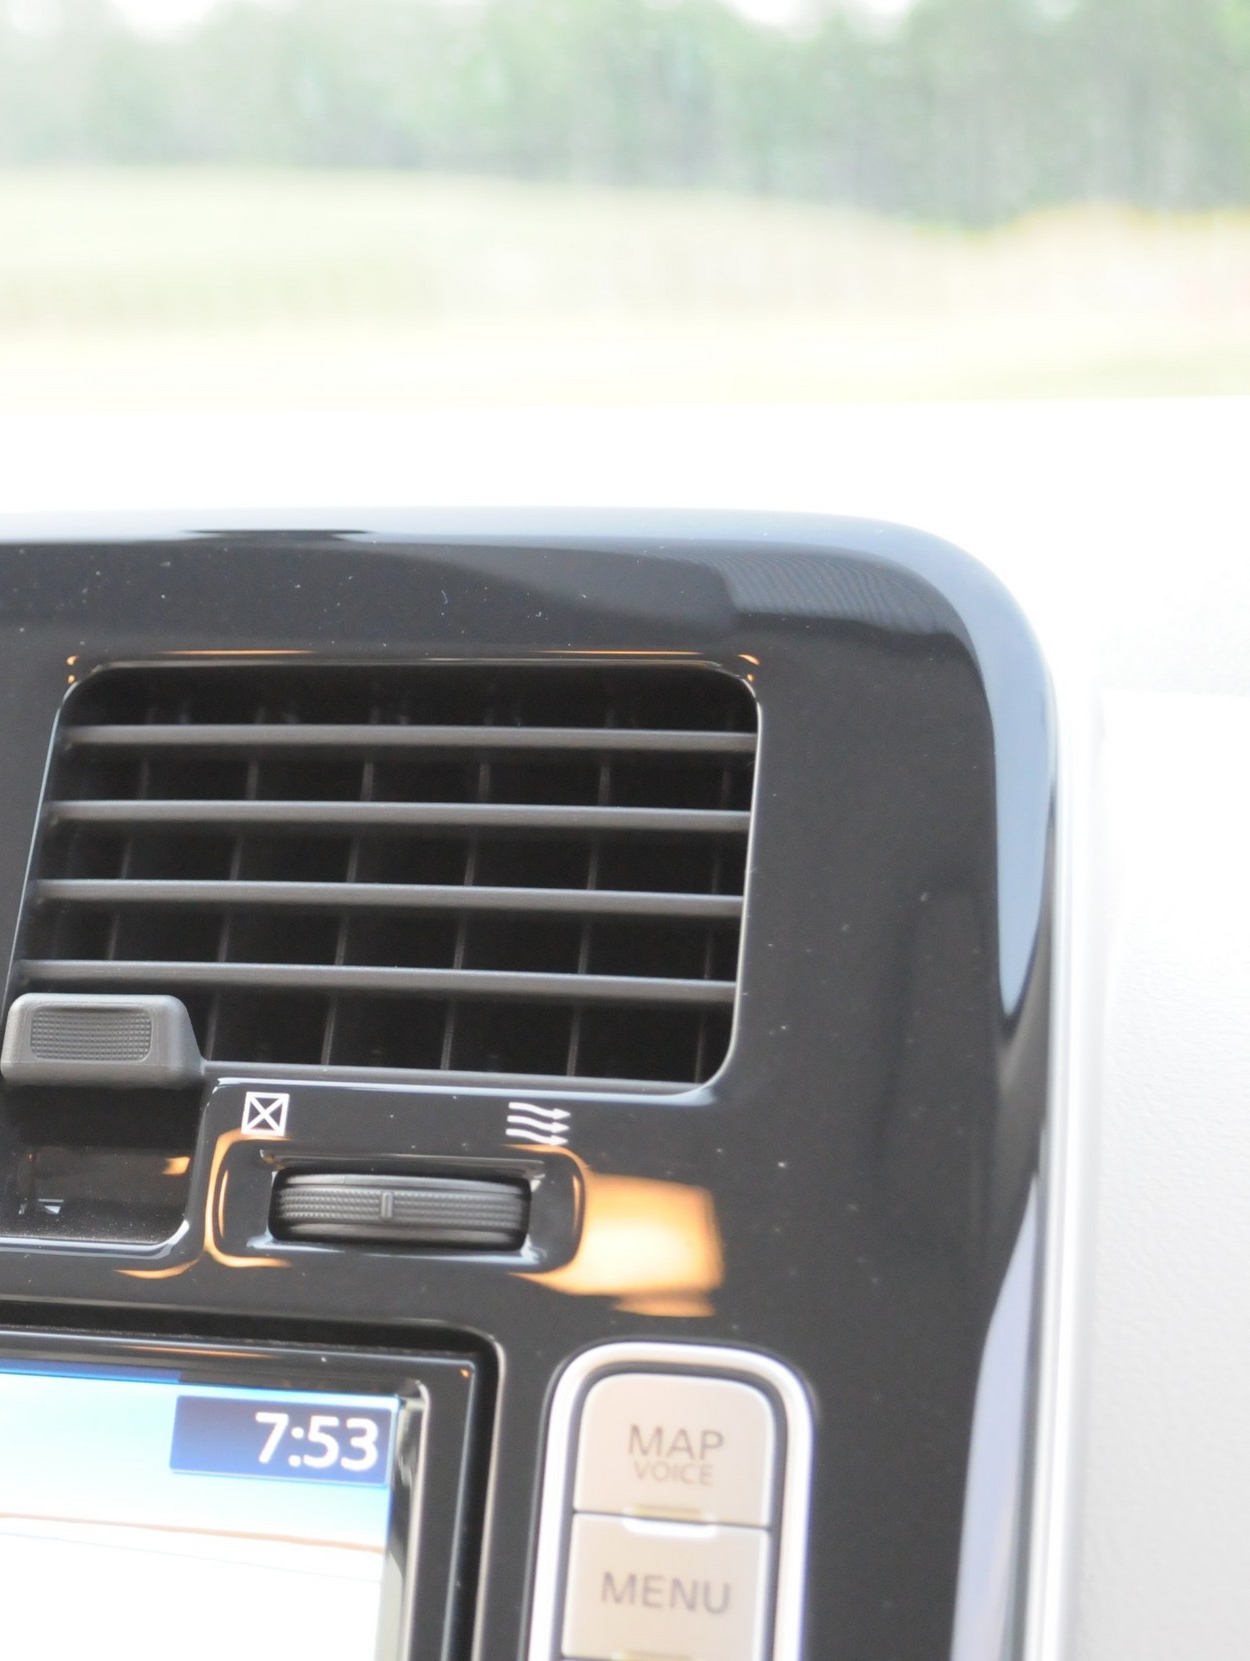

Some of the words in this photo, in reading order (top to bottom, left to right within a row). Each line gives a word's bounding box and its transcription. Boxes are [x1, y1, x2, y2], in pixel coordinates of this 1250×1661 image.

[255, 1412, 378, 1471] 7:53
[627, 1423, 725, 1461] MAP
[632, 1460, 714, 1486] VOICE
[599, 1570, 731, 1616] MENU
